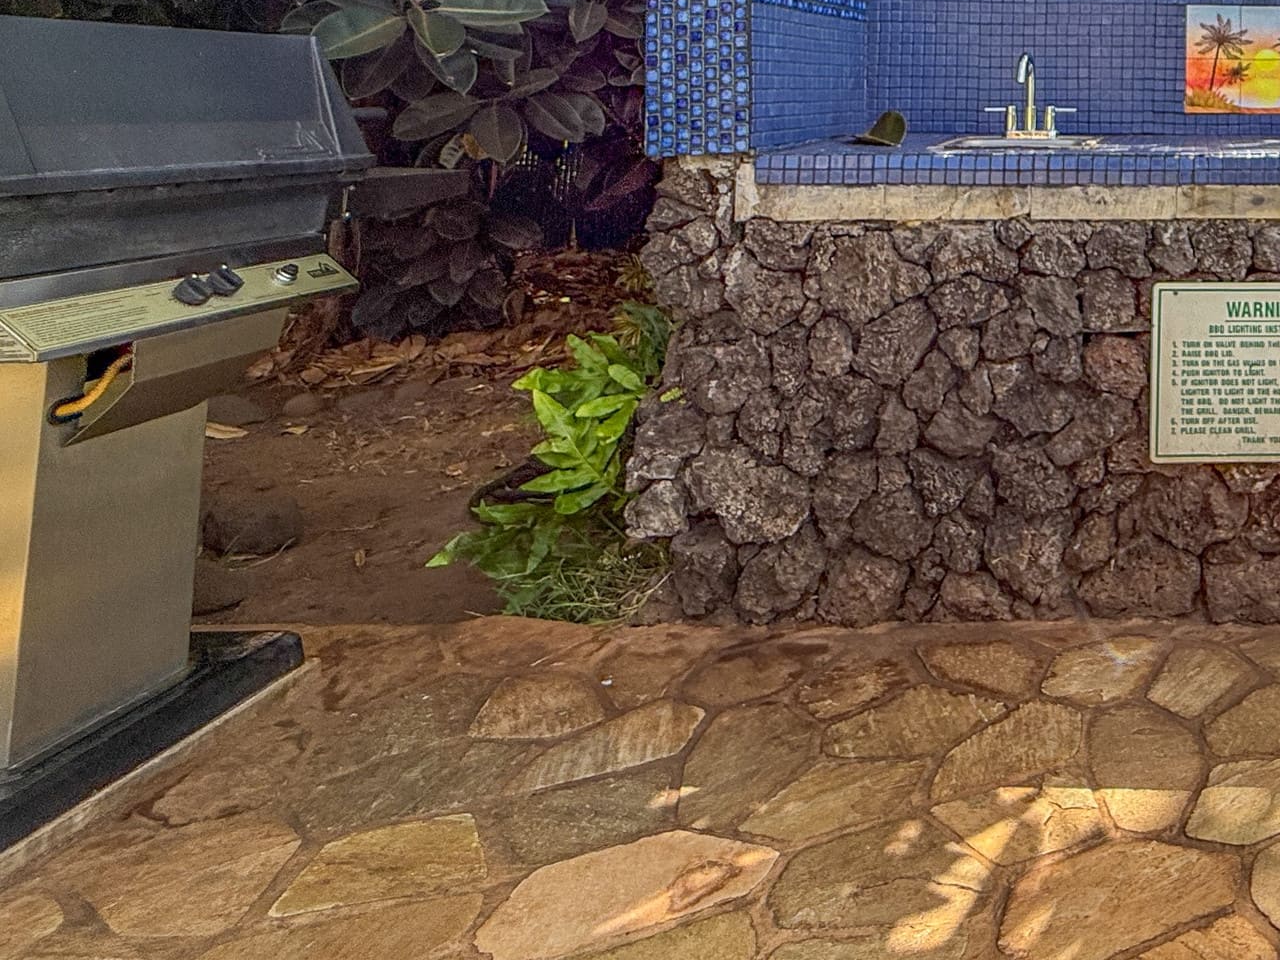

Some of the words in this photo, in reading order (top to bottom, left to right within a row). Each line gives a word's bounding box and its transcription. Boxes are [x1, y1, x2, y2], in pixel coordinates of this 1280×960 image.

[1208, 324, 1224, 334] BBQ
[1228, 324, 1262, 334] LIGHTING
[1182, 350, 1202, 358] RAISE
[1204, 350, 1219, 358] BBQ
[1182, 359, 1200, 367] TURN
[1200, 359, 1210, 367] ON
[1212, 359, 1225, 367] THE
[1226, 359, 1240, 367] GAS
[1268, 359, 1276, 367] ON
